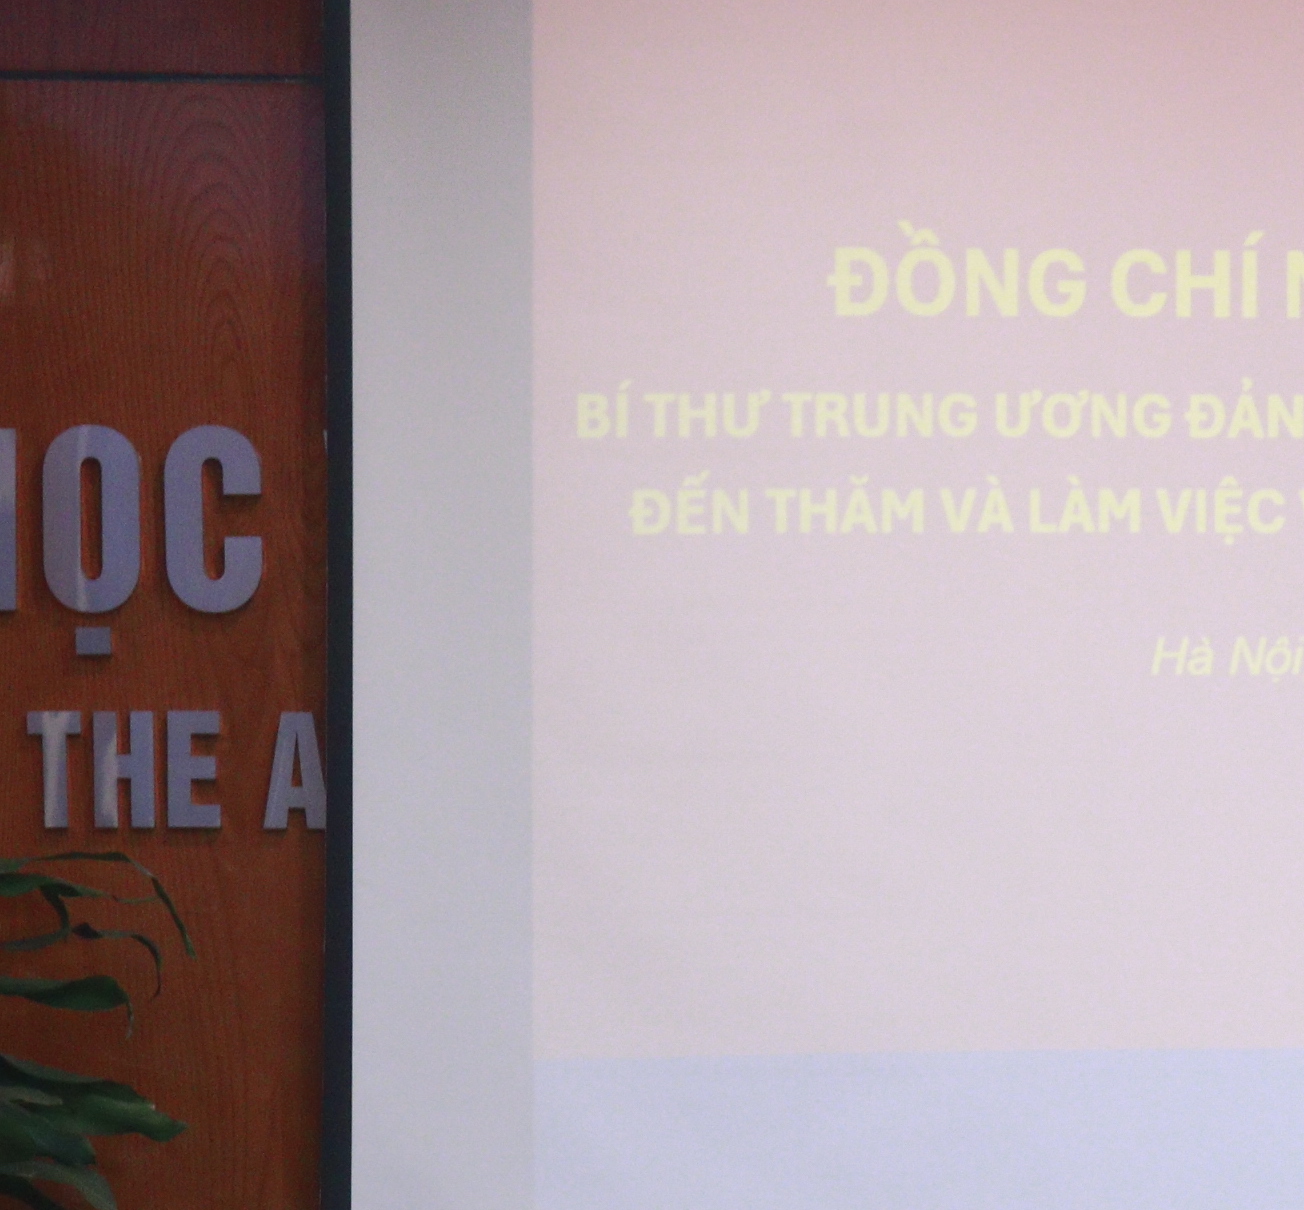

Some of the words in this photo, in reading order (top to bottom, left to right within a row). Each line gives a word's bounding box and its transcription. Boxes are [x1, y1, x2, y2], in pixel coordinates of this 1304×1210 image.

[827, 219, 1087, 318] ĐỒNG
[1111, 230, 1264, 319] CHÍ
[577, 380, 632, 438] BÍ
[645, 389, 771, 437] THƯ
[784, 392, 978, 438] TRUNG
[995, 388, 1172, 438] ƯƠNG
[629, 470, 749, 535] ĐẾN
[767, 476, 925, 533] THĂM
[941, 476, 1012, 533] VÀ
[1029, 475, 1142, 533] LÀM
[1157, 476, 1284, 544] VIỆC
[1150, 636, 1216, 676] Hà
[27, 710, 221, 828] THE
